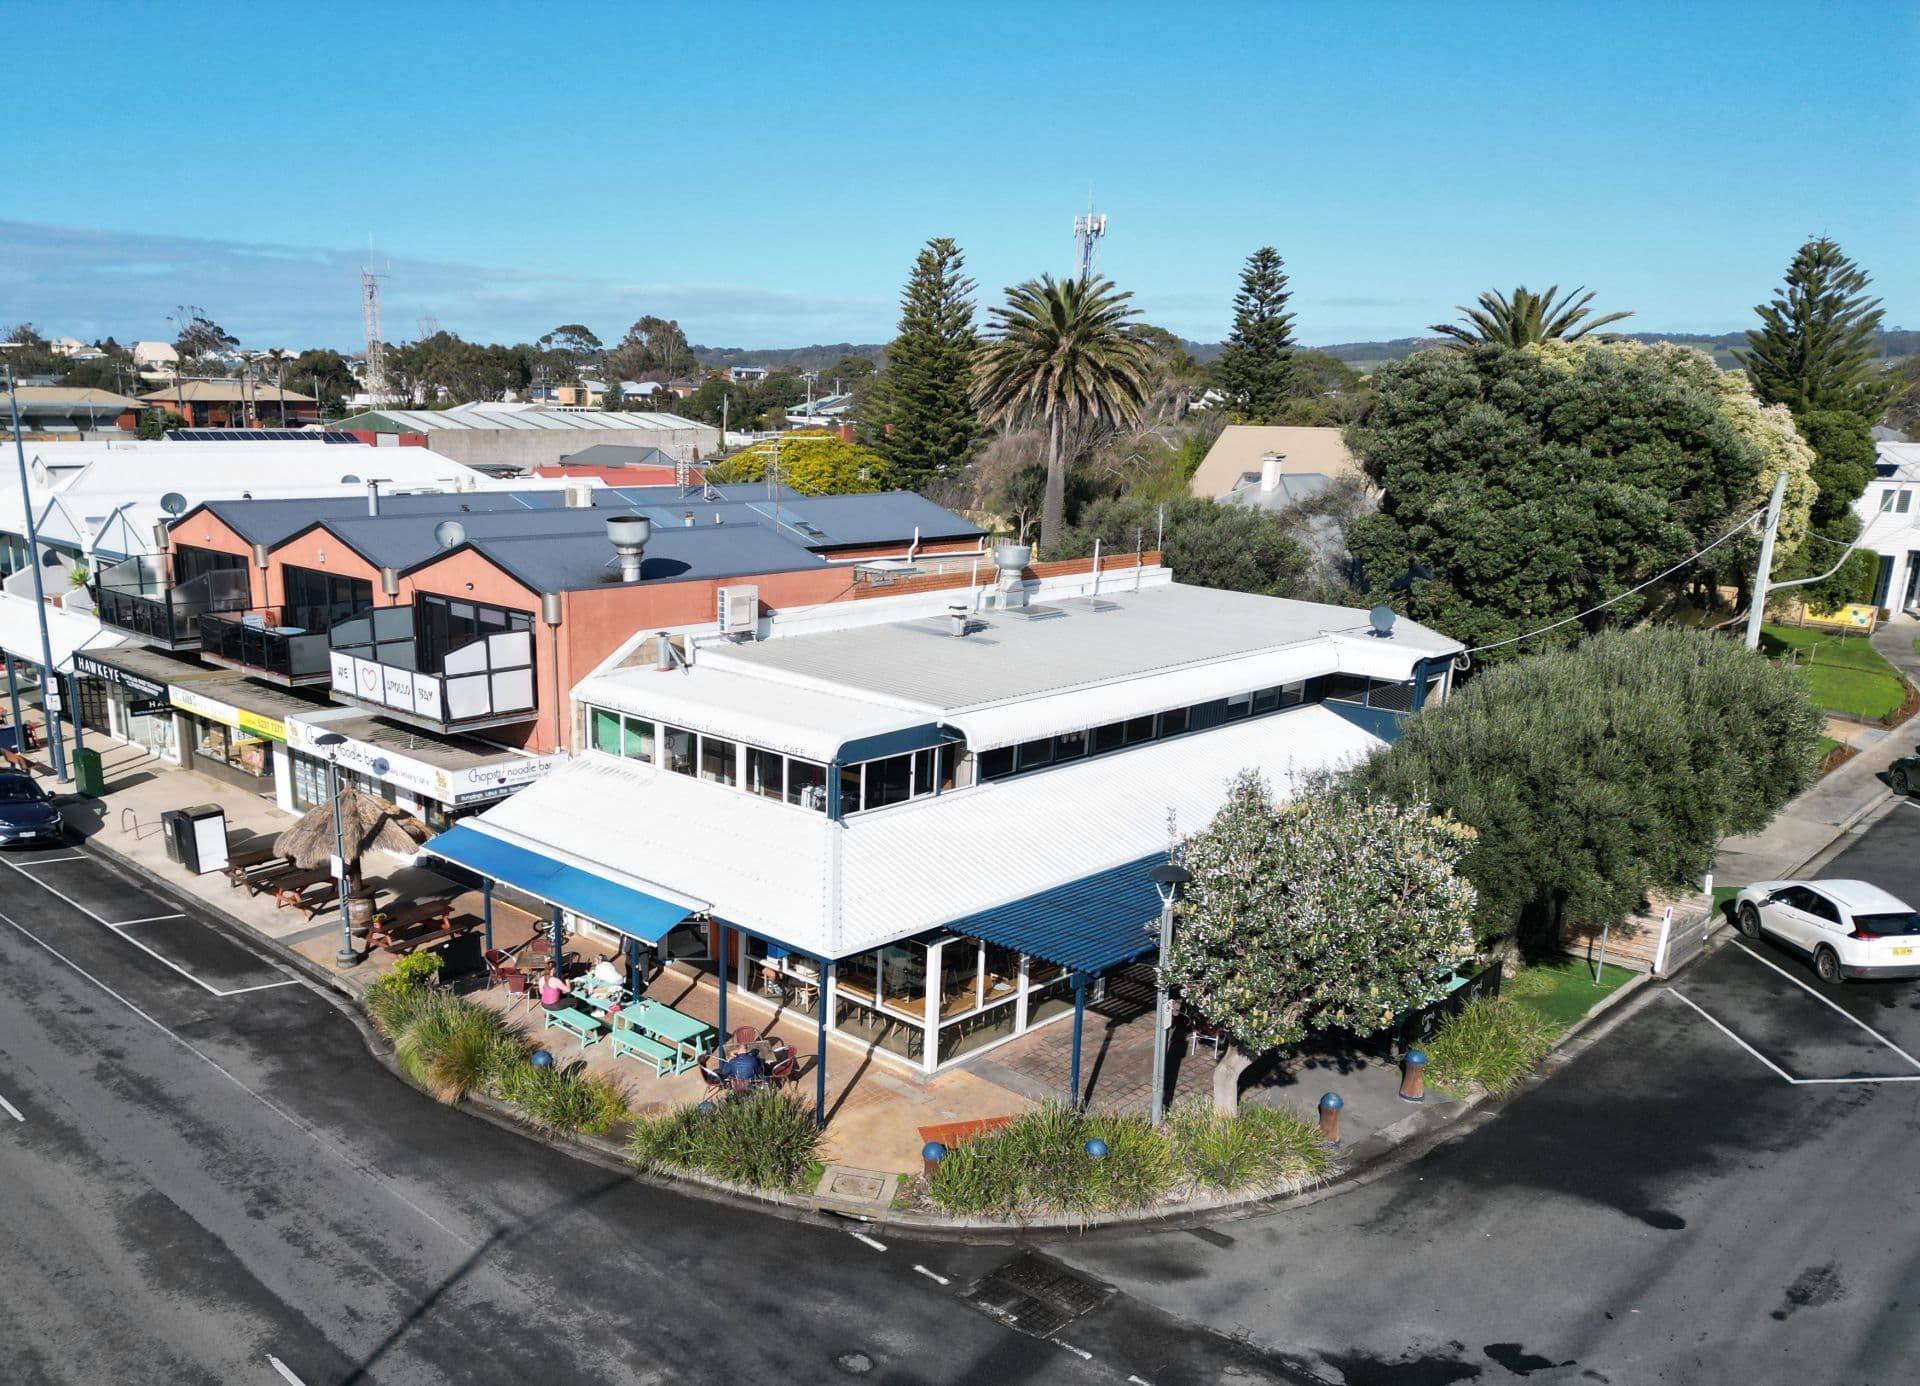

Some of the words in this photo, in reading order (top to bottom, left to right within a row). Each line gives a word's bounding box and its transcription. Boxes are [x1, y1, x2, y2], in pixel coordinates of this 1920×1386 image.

[77, 656, 121, 683] HAWKEYE
[337, 666, 349, 679] WE
[387, 680, 411, 696] APOLLO
[418, 687, 433, 701] BAY
[507, 761, 537, 777] noodle
[538, 760, 553, 771] bar
